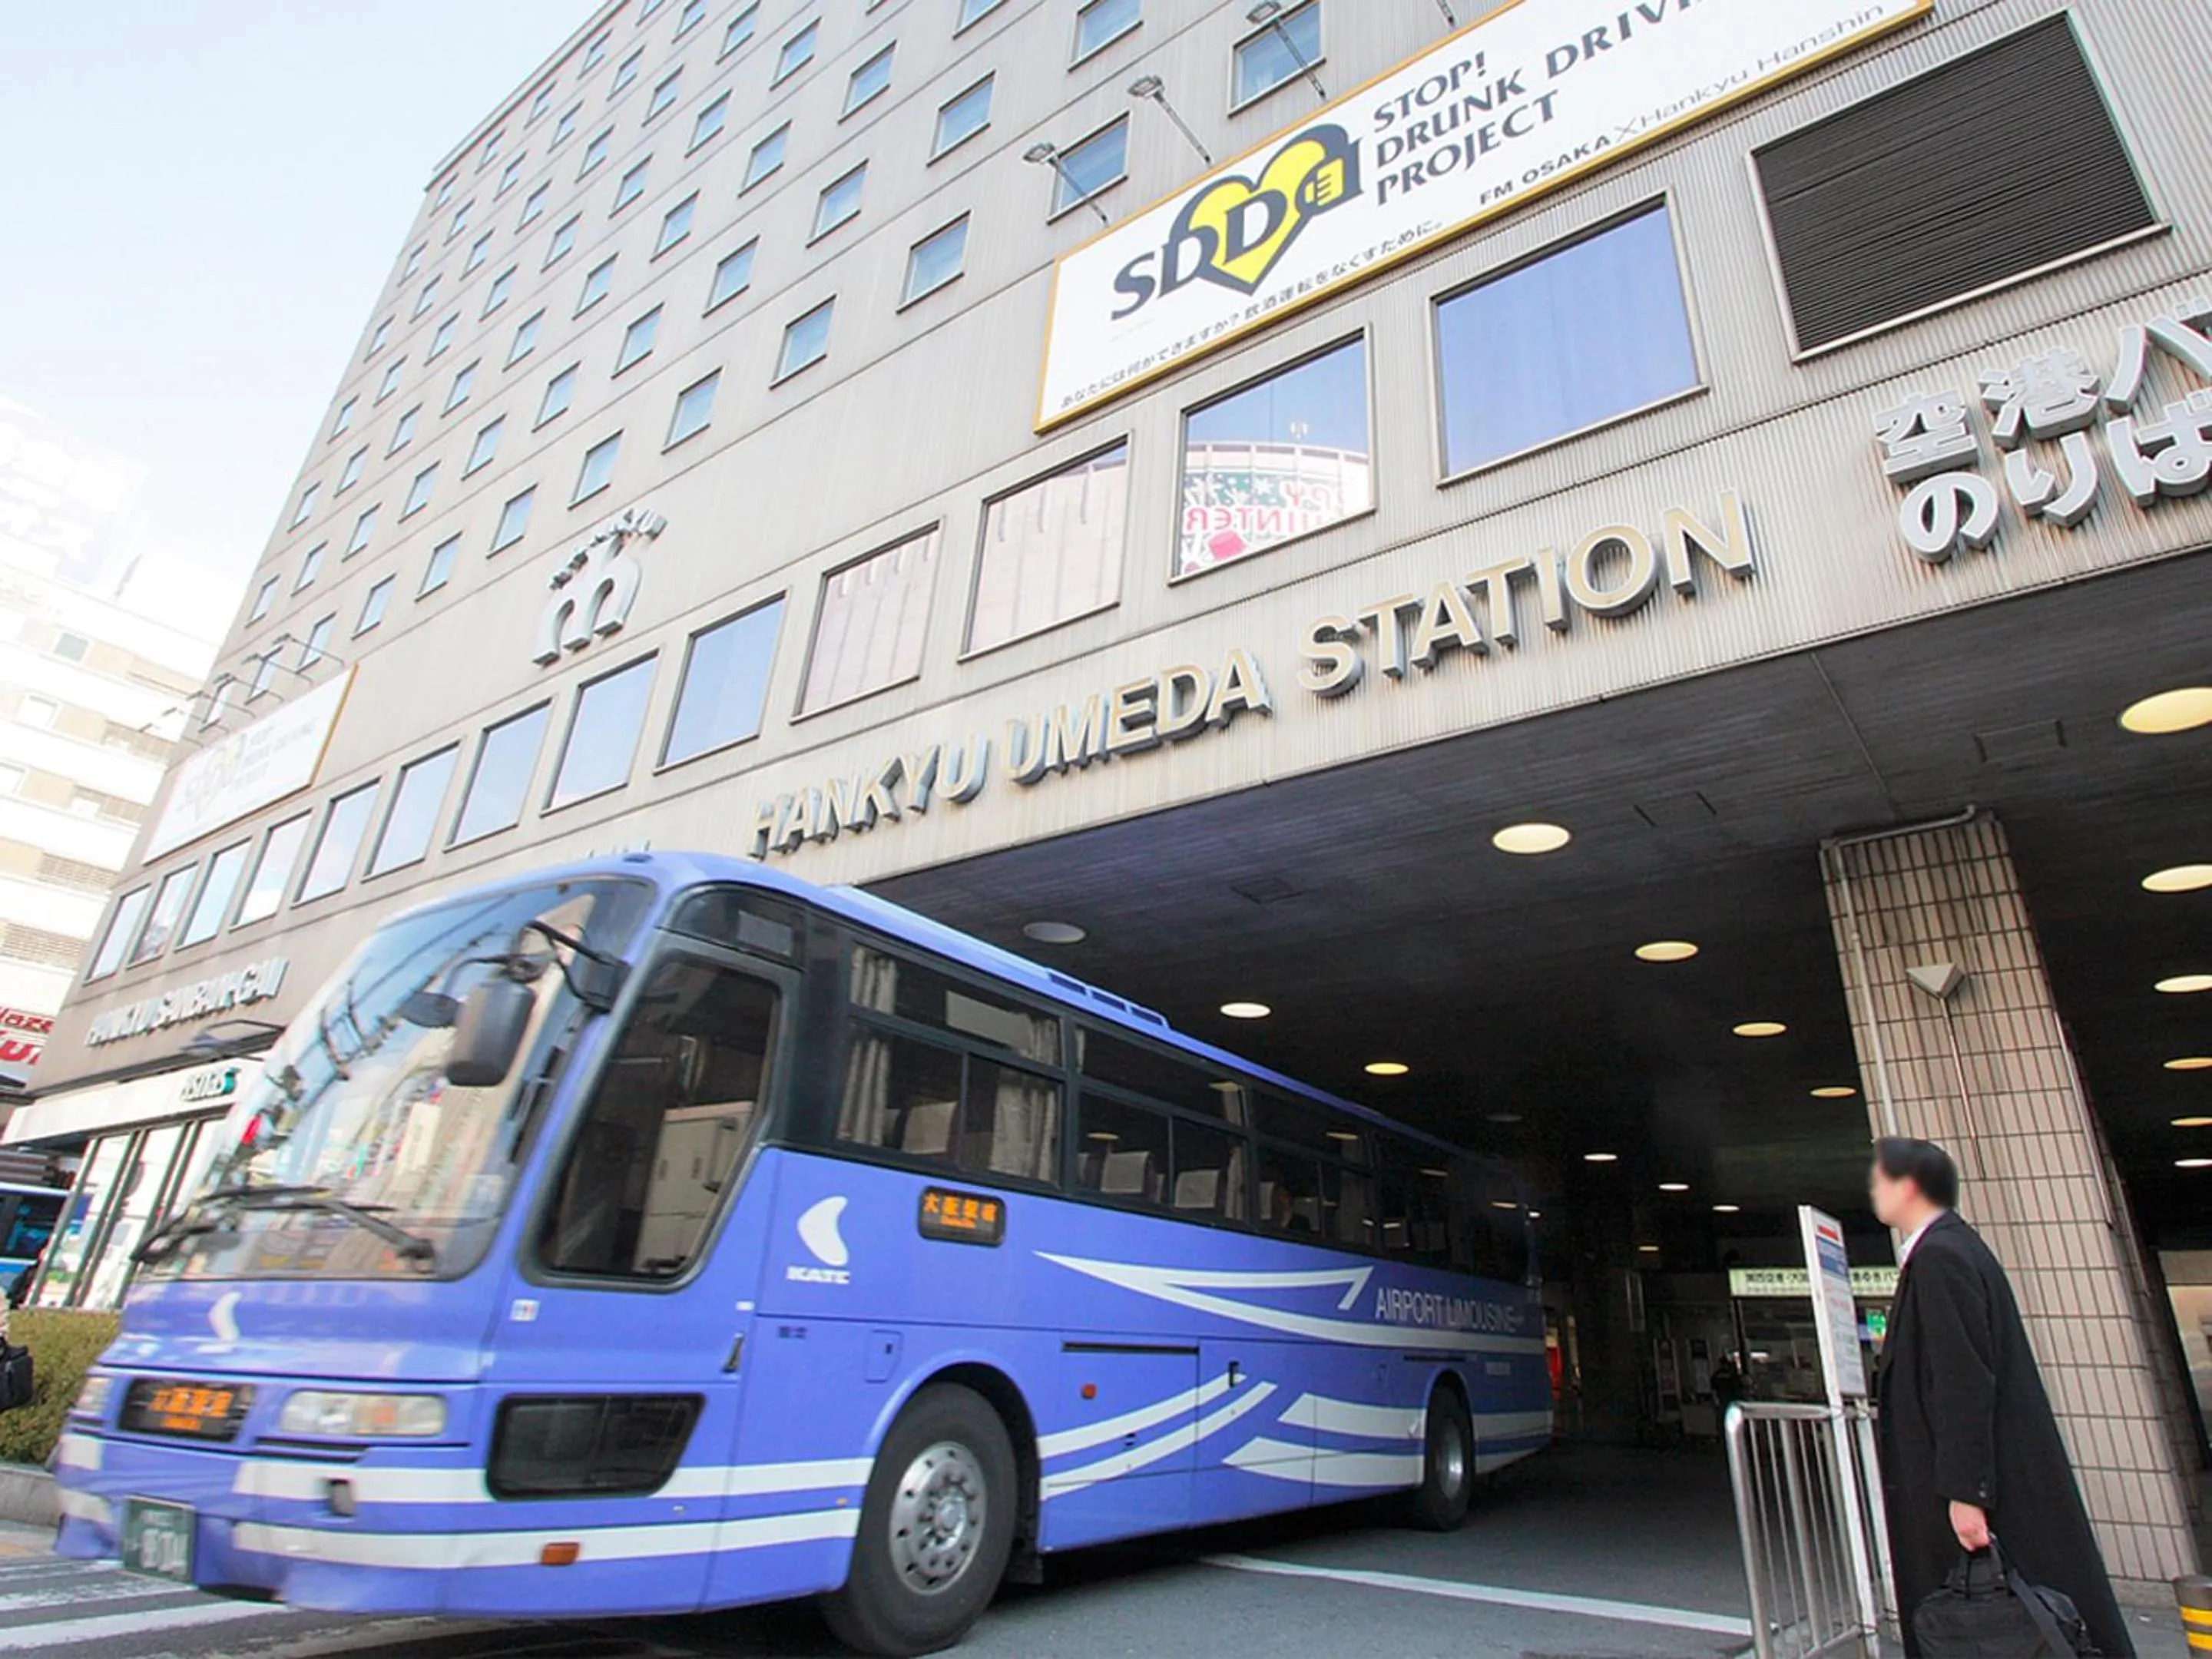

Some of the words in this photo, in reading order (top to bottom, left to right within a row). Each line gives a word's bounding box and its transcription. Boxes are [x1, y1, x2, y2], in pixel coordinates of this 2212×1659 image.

[1374, 51, 1485, 133] STOP!
[1376, 68, 1527, 168] DRUNK
[1377, 90, 1559, 207] PROJECT
[1479, 181, 1514, 205] FM
[1758, 4, 1884, 71] Hanshin
[1899, 386, 2212, 562] のりば
[749, 733, 988, 860] HANKYU
[1005, 647, 1273, 785] UMEDA
[1296, 485, 1756, 697] STATION
[1376, 1287, 1443, 1326] AIRPORT
